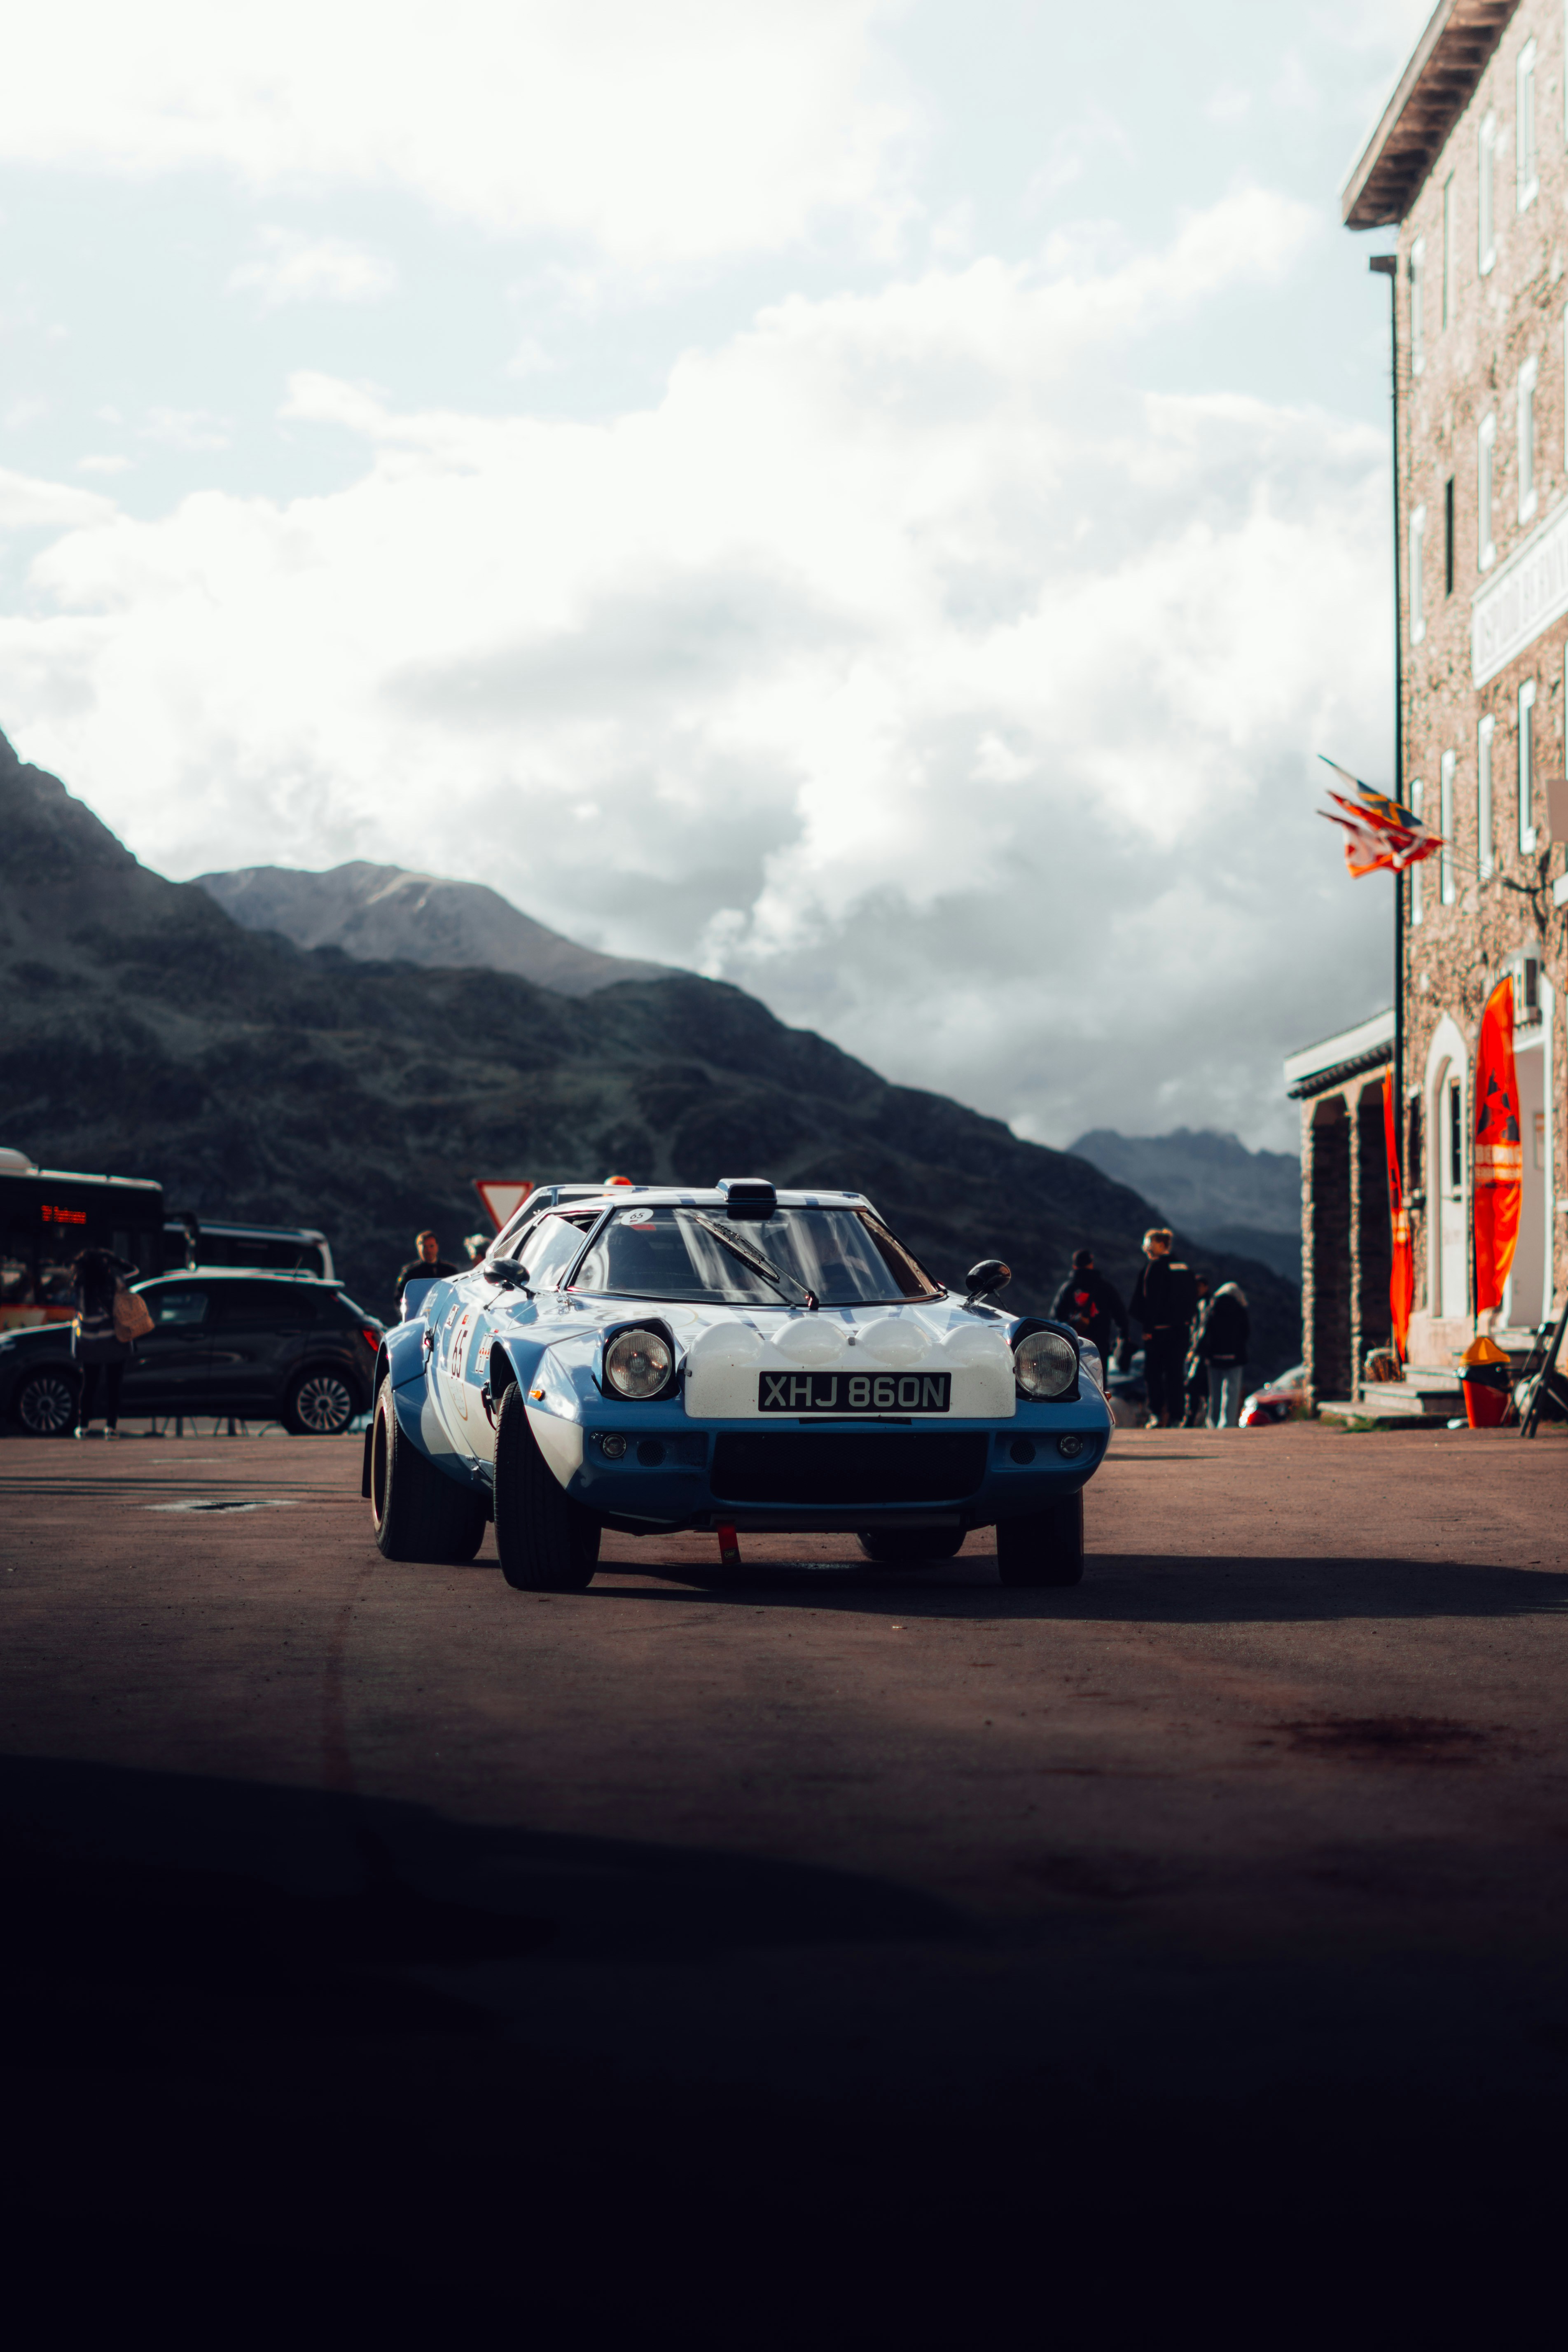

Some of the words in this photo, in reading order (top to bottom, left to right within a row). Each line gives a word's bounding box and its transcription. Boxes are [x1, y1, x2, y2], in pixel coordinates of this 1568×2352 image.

[452, 1330, 468, 1379] 65
[764, 1376, 838, 1407] XHJ
[848, 1377, 945, 1407] 860N
